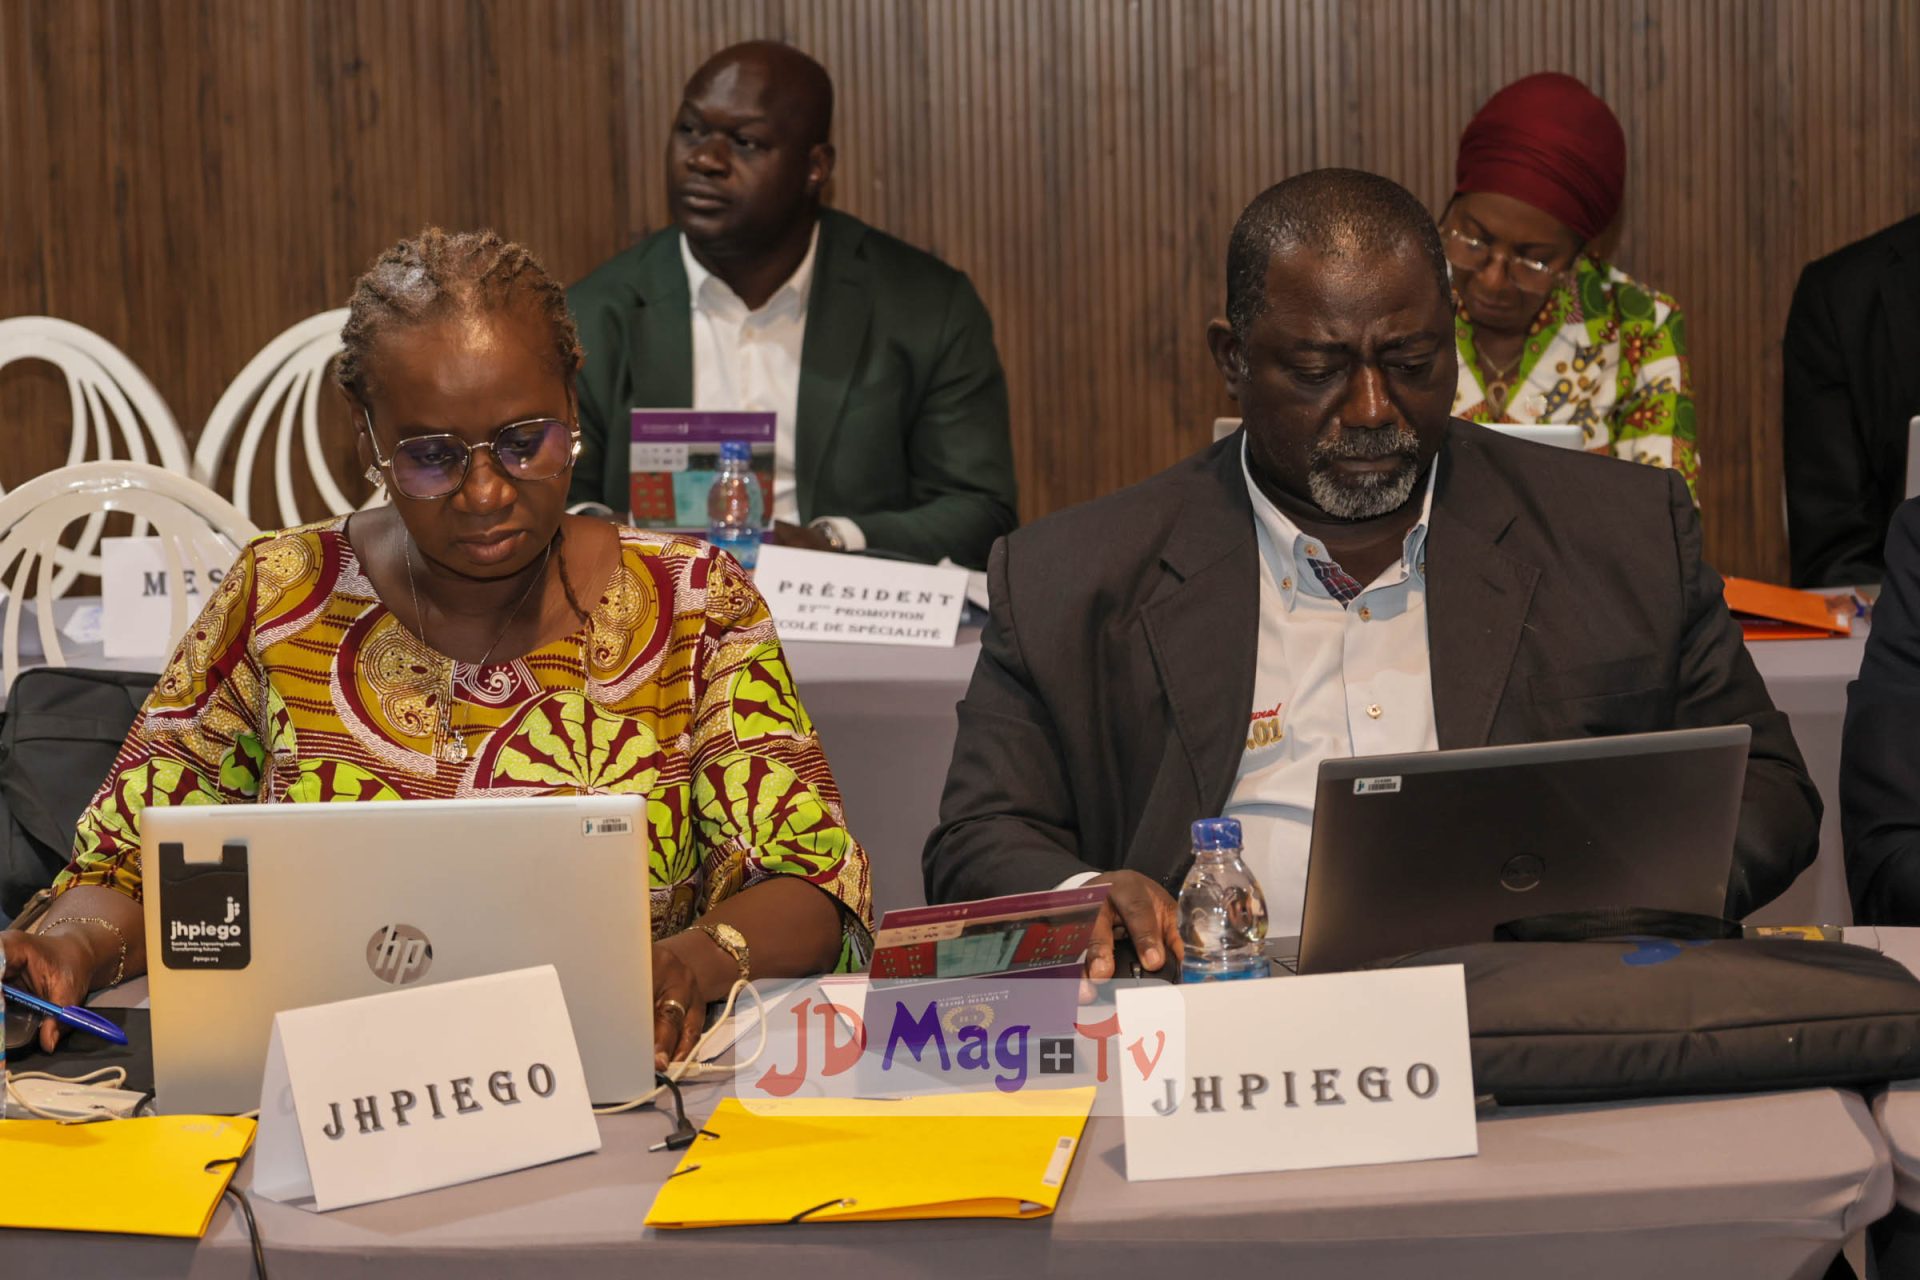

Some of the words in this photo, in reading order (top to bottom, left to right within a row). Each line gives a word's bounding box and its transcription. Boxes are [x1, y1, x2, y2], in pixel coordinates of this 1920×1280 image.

[778, 580, 954, 606] PRÉSIDENT
[835, 606, 925, 621] PROMOTION
[773, 618, 819, 632] COLE
[824, 622, 843, 632] DE
[848, 622, 941, 639] SPÉCIALITÉ
[170, 920, 241, 940] jhpiego
[374, 923, 427, 985] hp
[323, 1063, 556, 1140] JHPIEGO
[1151, 1062, 1439, 1116] JHPIEGO
